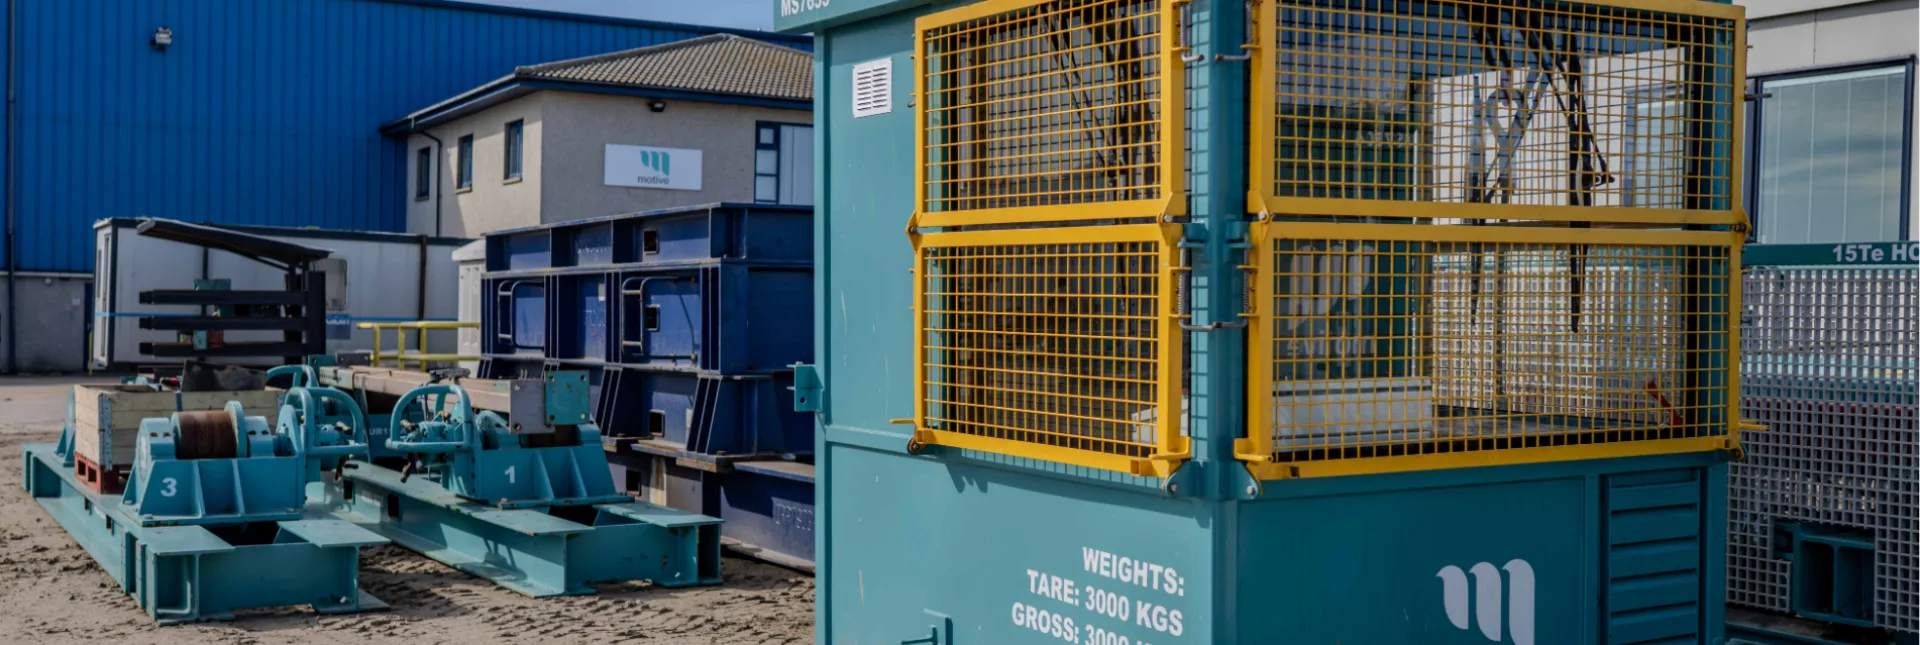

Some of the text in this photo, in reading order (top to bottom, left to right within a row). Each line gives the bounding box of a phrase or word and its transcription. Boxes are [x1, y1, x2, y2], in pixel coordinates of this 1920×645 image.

[637, 175, 670, 185] motive
[1832, 244, 1885, 262] 15Te
[505, 465, 515, 484] 1
[160, 477, 177, 497] 3
[1082, 546, 1185, 597] WEIGHTS:
[1027, 568, 1184, 637] TARE: 3000 KGS
[1012, 602, 1079, 645] GROSS:
